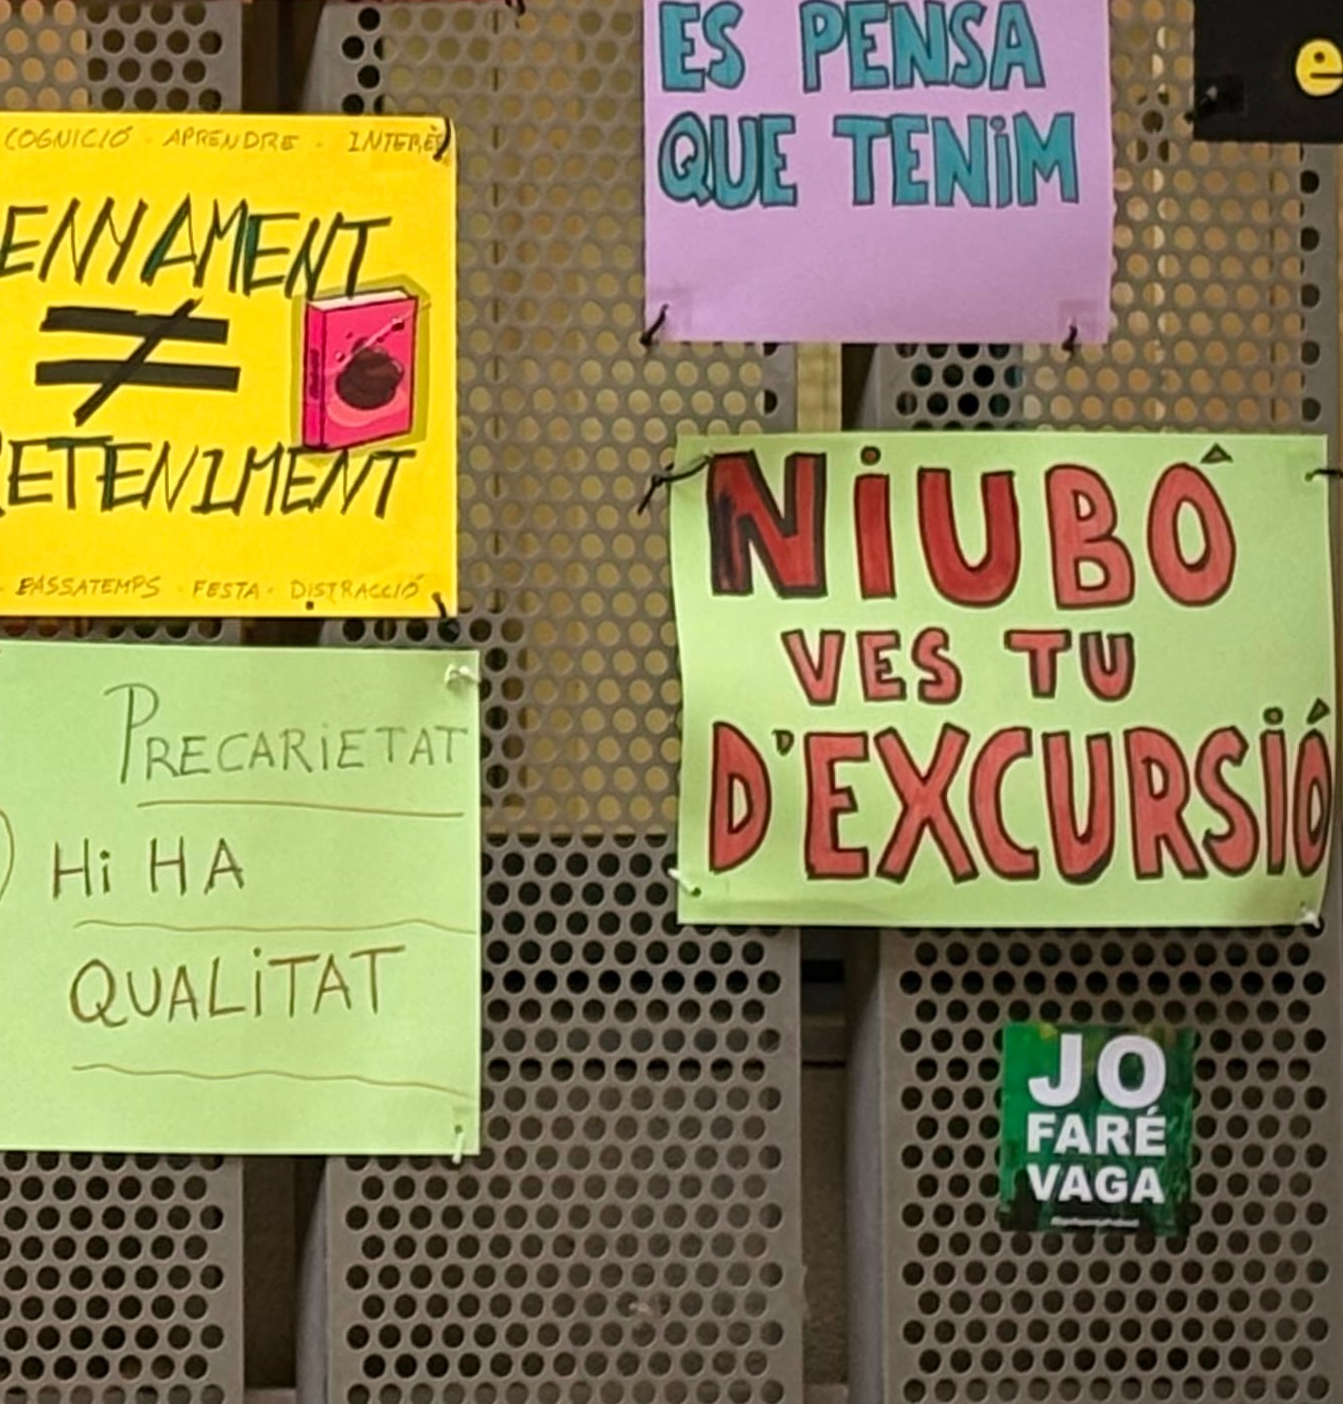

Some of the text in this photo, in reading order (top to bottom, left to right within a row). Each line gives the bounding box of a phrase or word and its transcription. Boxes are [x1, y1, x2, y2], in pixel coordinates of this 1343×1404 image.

[659, 0, 1046, 93] ES PENSA
[4, 125, 133, 150] COGNICIÓ
[164, 127, 299, 152] APRENDRE
[658, 111, 798, 210] QUE
[193, 579, 259, 599] FESTA
[290, 573, 425, 602] DISTRACCIÓ
[781, 626, 1135, 705] VES TU
[151, 837, 245, 895] HA
[1028, 1033, 1166, 1109] JO
[1027, 1105, 1167, 1156] FARÉ
[1026, 1164, 1165, 1204] VAGA
